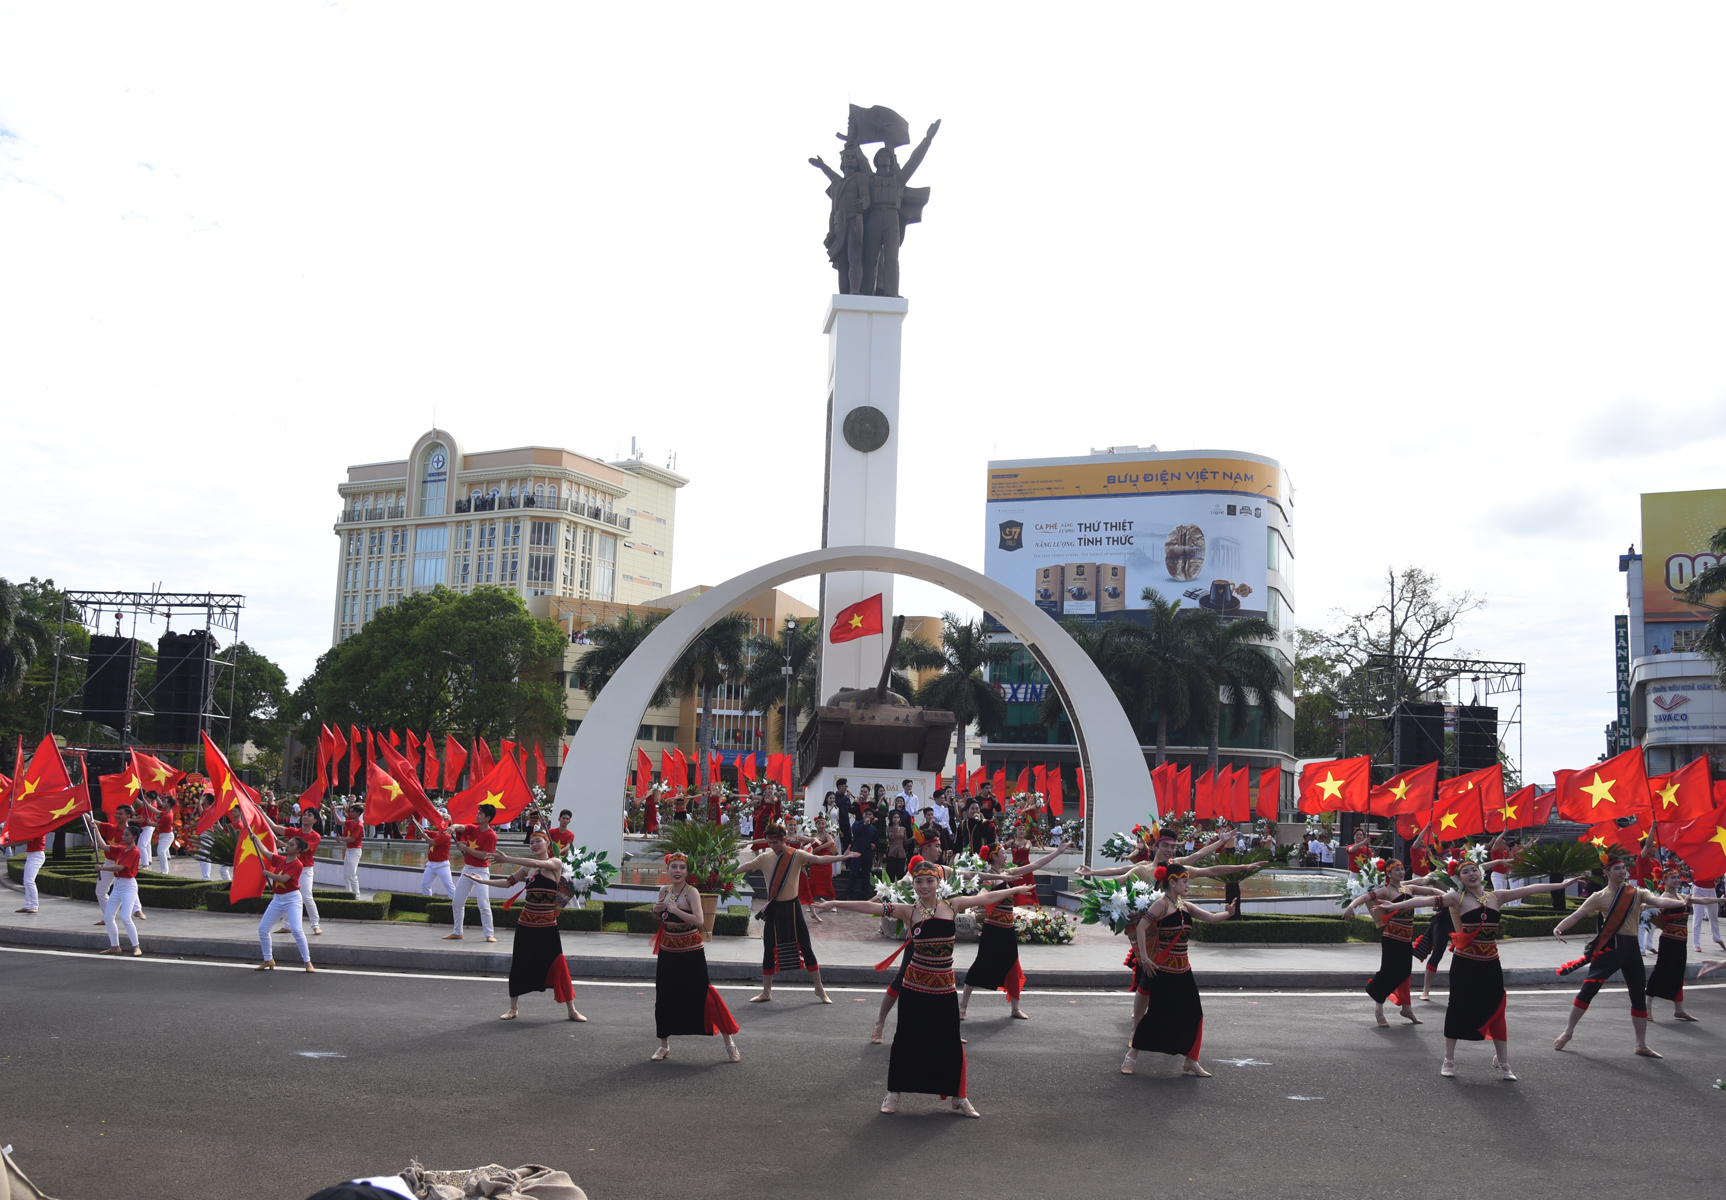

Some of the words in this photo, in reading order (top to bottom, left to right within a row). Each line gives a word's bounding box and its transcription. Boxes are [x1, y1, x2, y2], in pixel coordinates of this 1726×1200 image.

[1107, 473, 1139, 484] BƯU
[1185, 468, 1219, 482] VIỆT
[1223, 471, 1254, 483] NAM
[1001, 526, 1021, 539] G7
[1034, 522, 1044, 530] CÀ
[1045, 522, 1058, 530] PHÊ
[1077, 520, 1102, 532] THỨ
[1103, 519, 1134, 533] THIỆT
[1077, 534, 1102, 547] TỈNH
[1105, 534, 1134, 546] THỨC
[1616, 628, 1628, 657] TÂN
[1617, 661, 1630, 702] THÁI
[1654, 713, 1688, 723] DAVACO
[1618, 706, 1630, 746] BÌNH
[886, 782, 899, 792] ĐÀI
